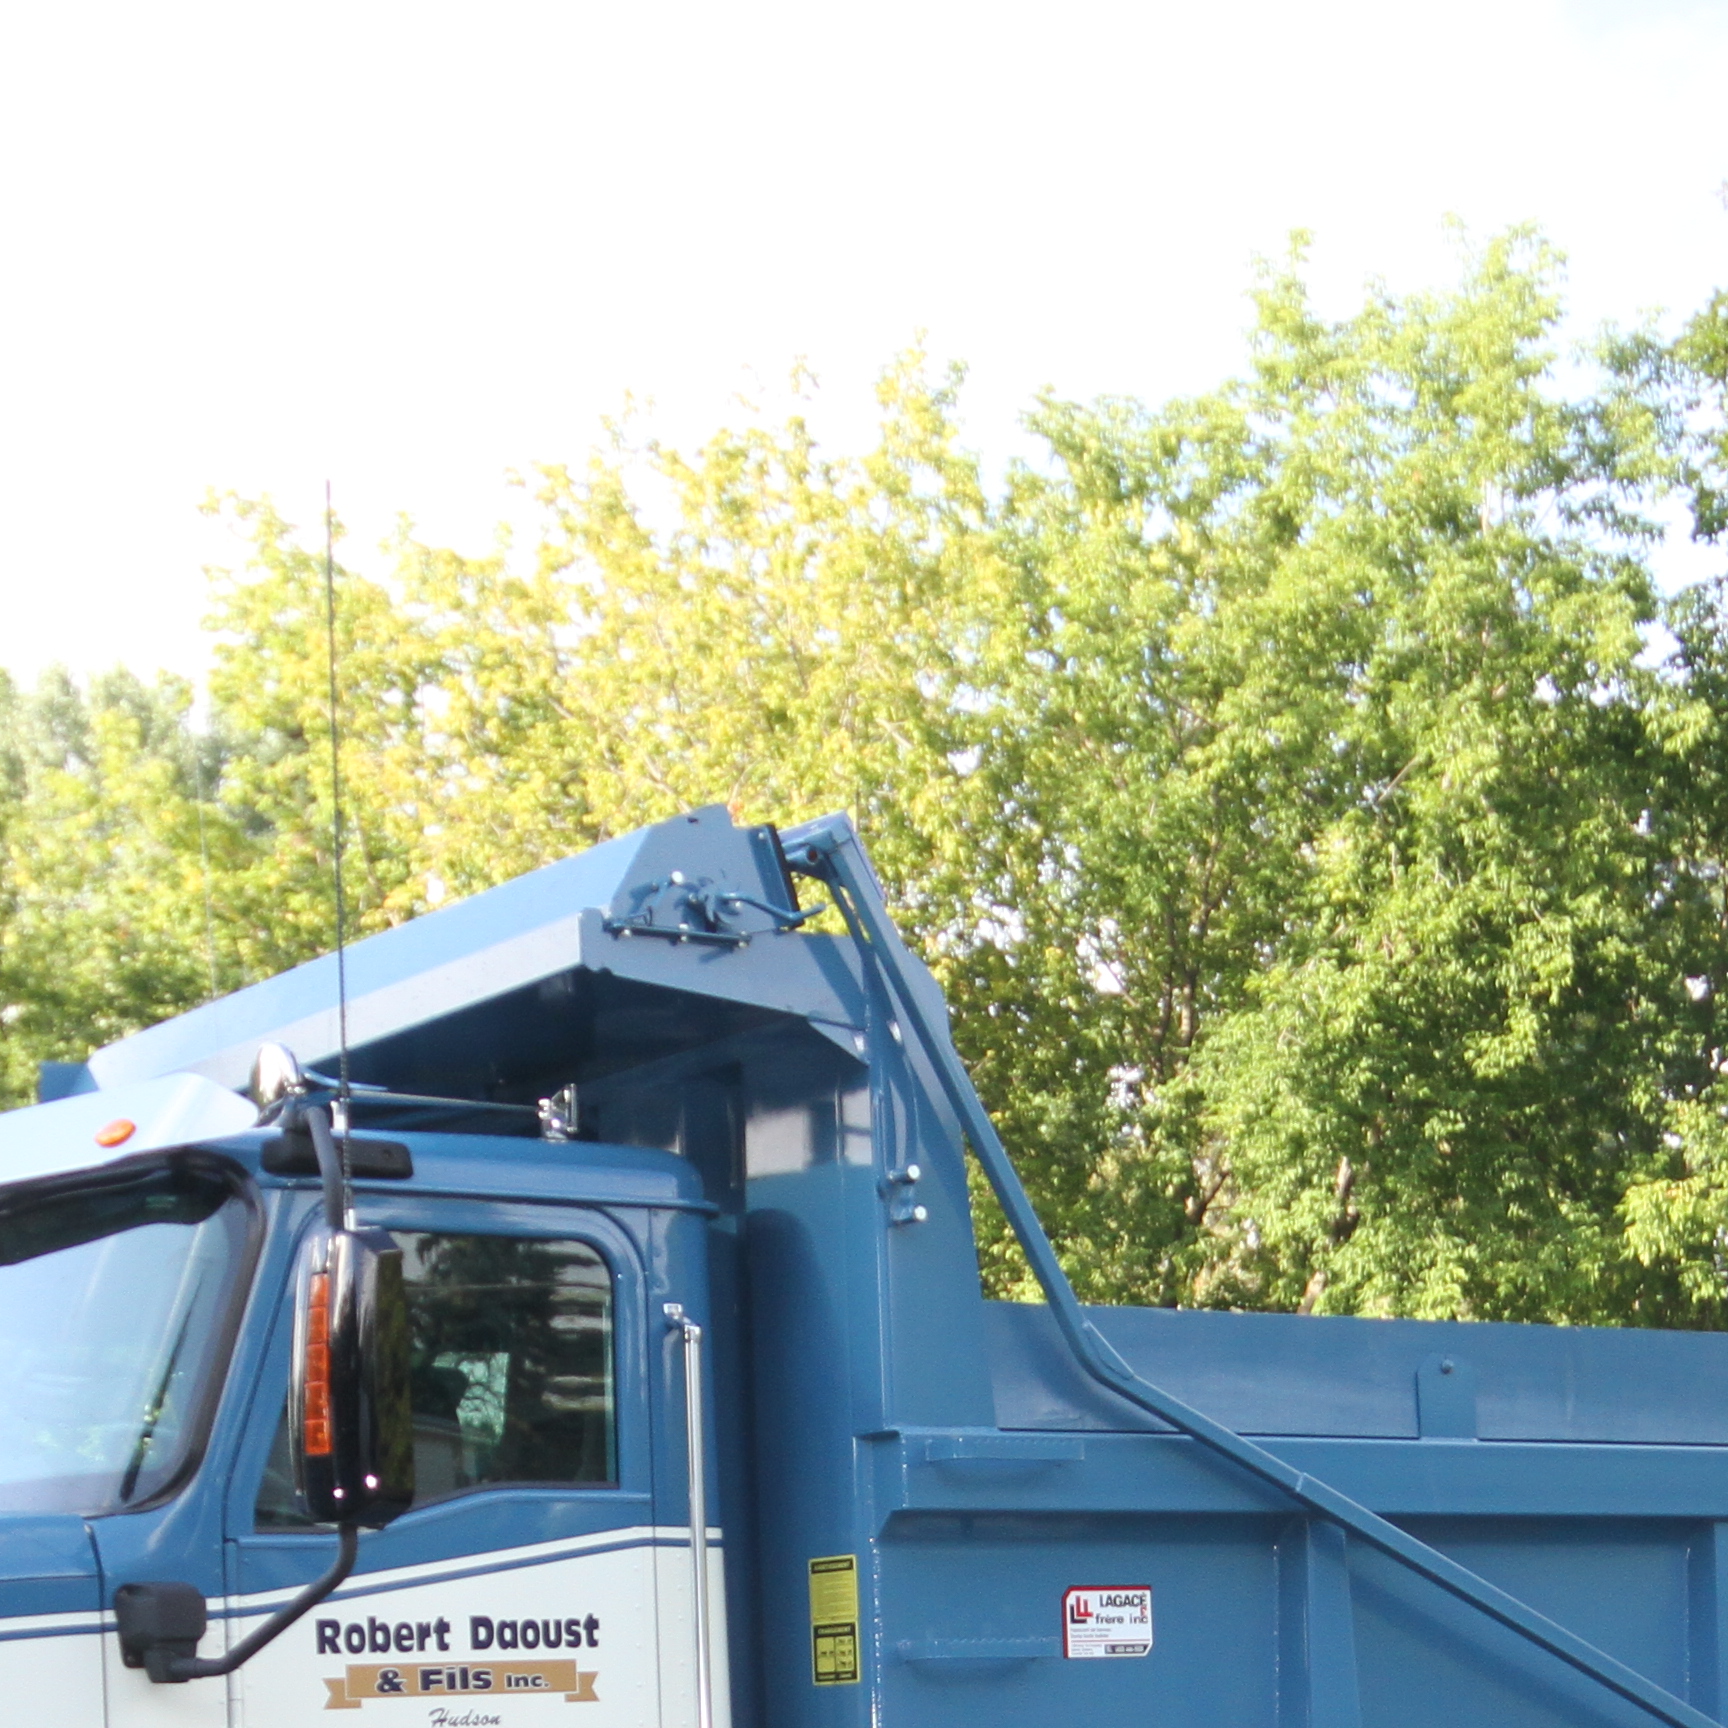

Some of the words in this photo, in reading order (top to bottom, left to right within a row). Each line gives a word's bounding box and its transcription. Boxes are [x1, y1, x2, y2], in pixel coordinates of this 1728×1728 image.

[315, 1615, 451, 1655] Robert
[469, 1613, 600, 1651] Daoust
[375, 1667, 406, 1694] &
[418, 1665, 493, 1692] Fils
[428, 1707, 502, 1728] Hudson
